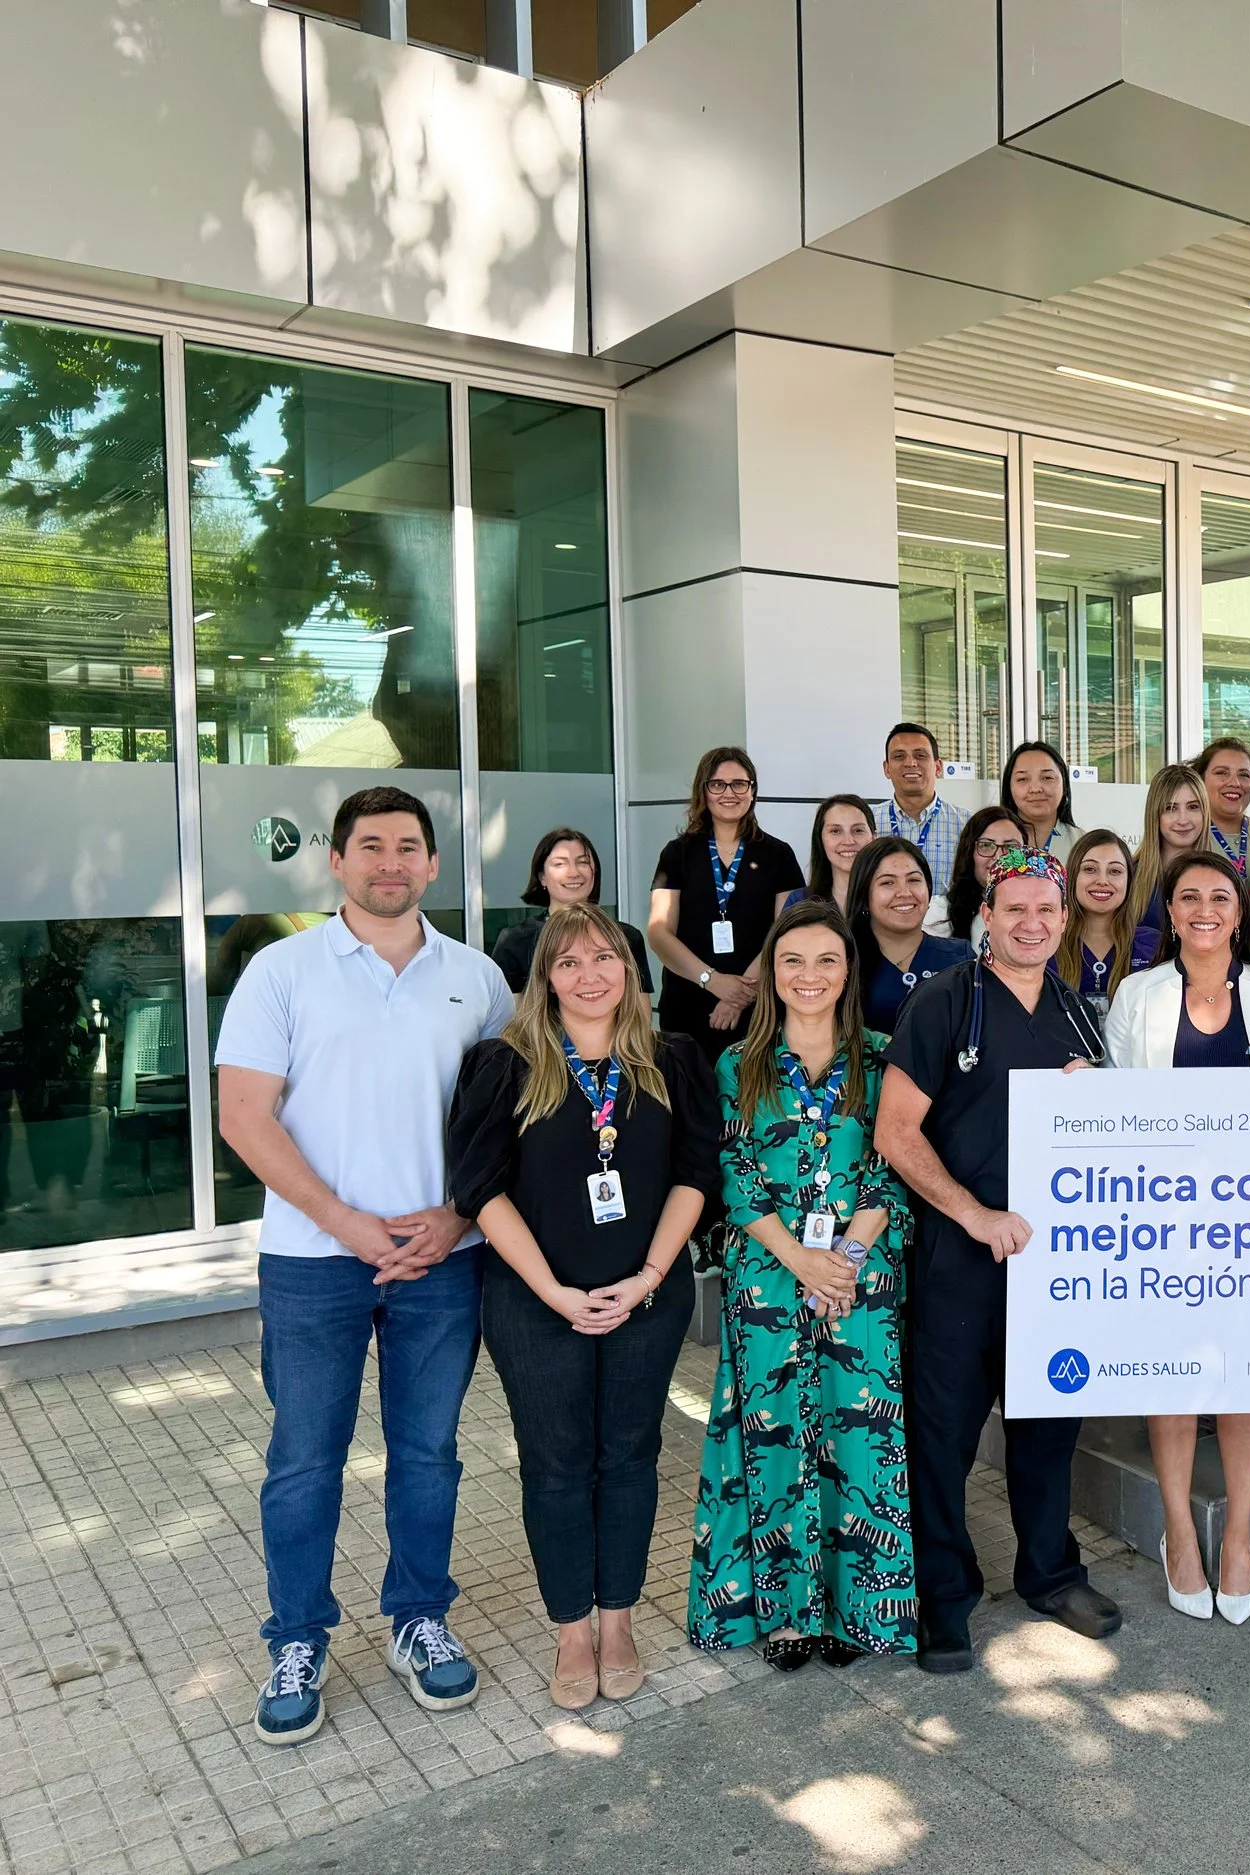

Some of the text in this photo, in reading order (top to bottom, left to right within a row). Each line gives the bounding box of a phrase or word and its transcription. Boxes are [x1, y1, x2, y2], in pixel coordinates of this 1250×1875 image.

[1054, 1114, 1116, 1132] Premio
[1121, 1114, 1178, 1132] Merco
[1184, 1113, 1233, 1131] Salud
[1051, 1165, 1197, 1204] Clínica
[1050, 1213, 1177, 1262] mejor
[1049, 1277, 1091, 1301] en
[1102, 1268, 1128, 1299] la
[1097, 1361, 1202, 1377] ANDES SALUD
